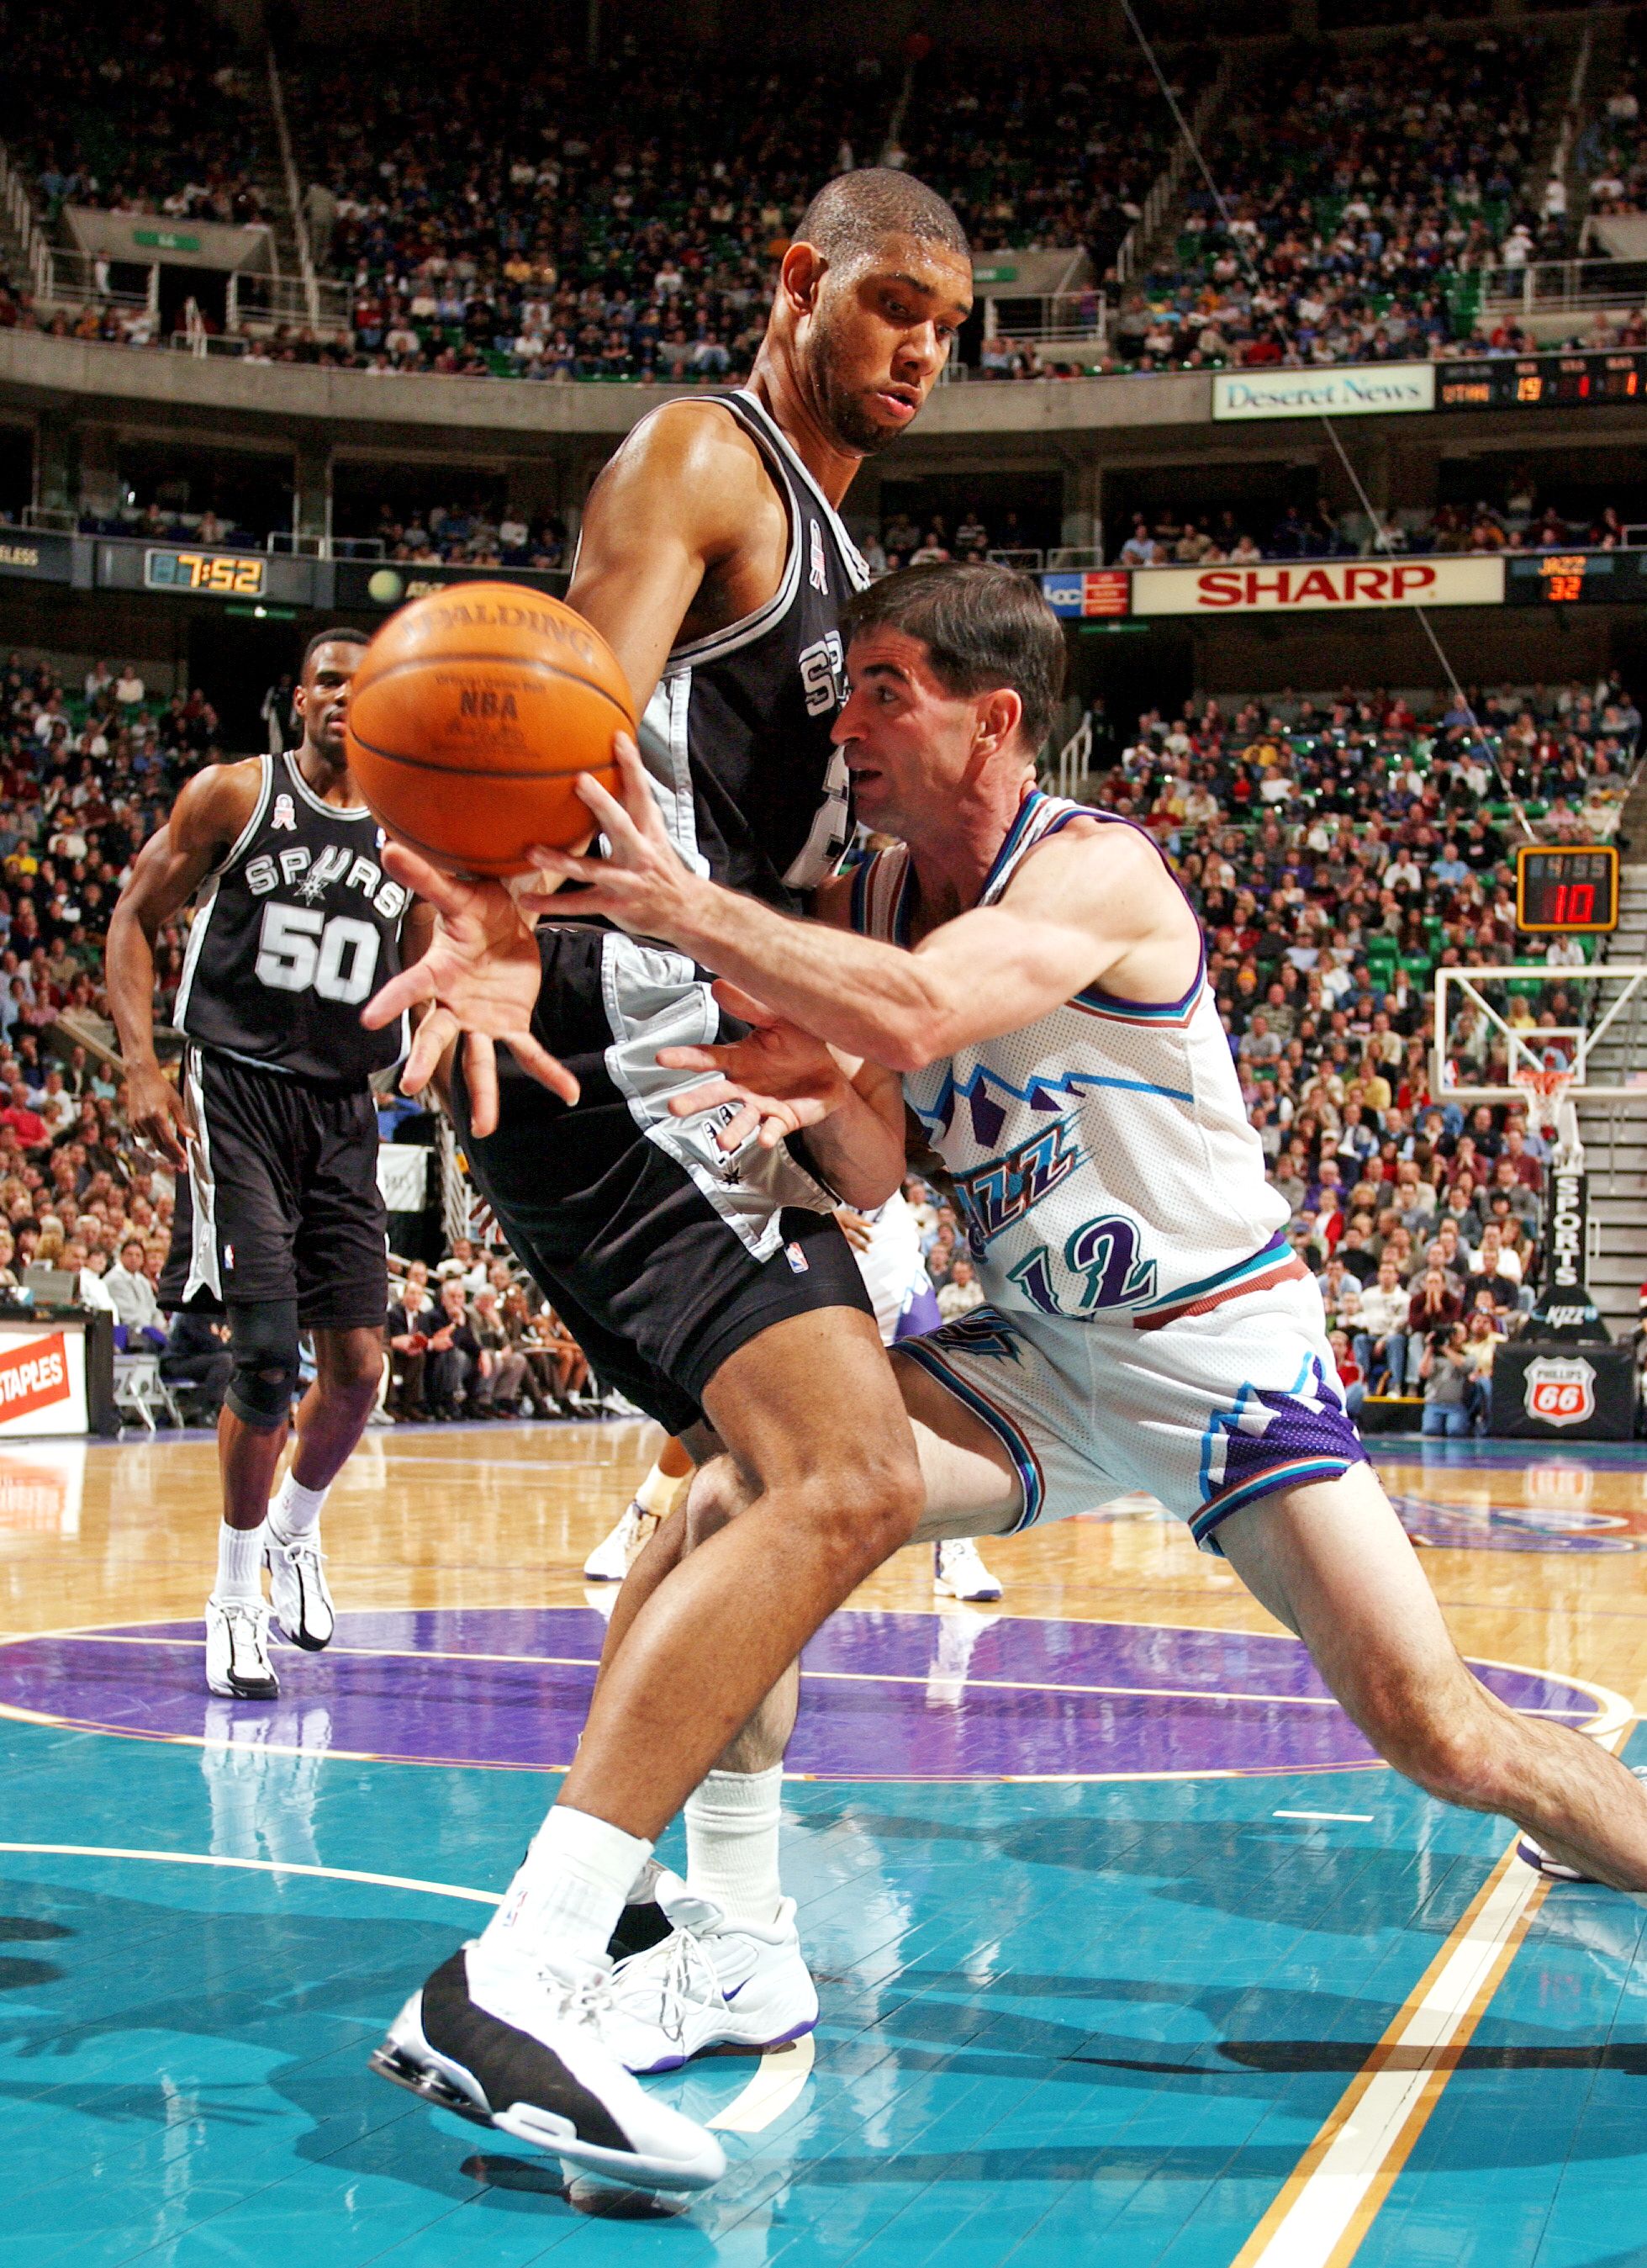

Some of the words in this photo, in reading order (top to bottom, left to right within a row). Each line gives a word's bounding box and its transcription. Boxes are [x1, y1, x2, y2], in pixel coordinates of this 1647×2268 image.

[1227, 383, 1334, 409] Deseret
[1343, 378, 1421, 404] News
[177, 554, 262, 593] 7:52
[1197, 564, 1436, 606] SHARP
[1548, 576, 1581, 601] 32
[460, 691, 518, 721] NBA
[245, 844, 406, 919] SPURS
[1554, 884, 1596, 923] 10
[254, 901, 381, 1005] 50
[1552, 1176, 1582, 1287] SPORTS
[1006, 1214, 1157, 1320] 12
[1538, 1385, 1581, 1411] 66
